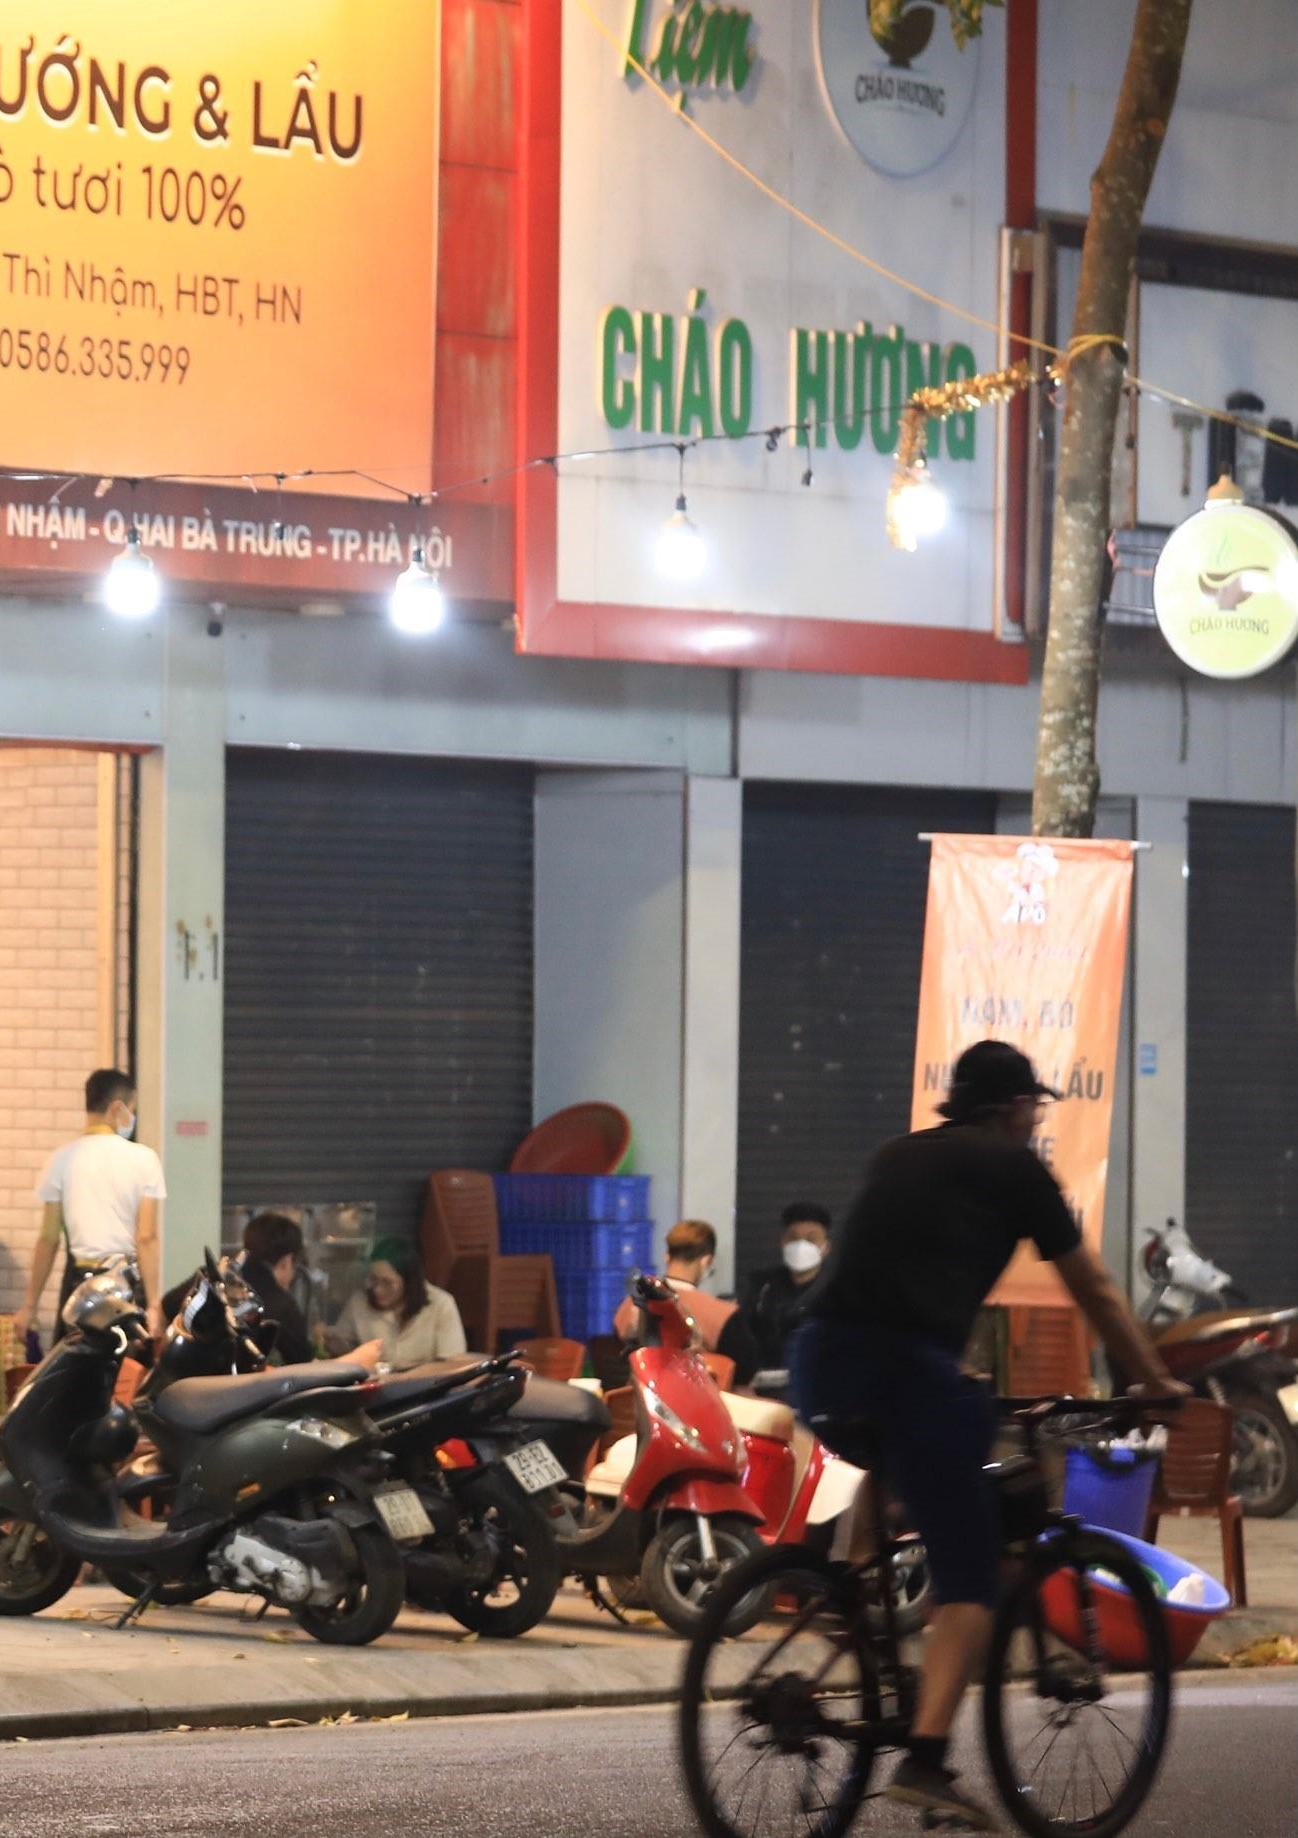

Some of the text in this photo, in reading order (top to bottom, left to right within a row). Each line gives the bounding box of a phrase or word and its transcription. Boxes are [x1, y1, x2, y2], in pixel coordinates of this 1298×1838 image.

[193, 74, 229, 141] &
[32, 155, 122, 217] tươi
[141, 164, 246, 231] 100%
[2, 252, 51, 298] Thì
[64, 260, 164, 319] Nhậm,
[175, 271, 245, 327] HBT,
[256, 281, 302, 325] HN
[596, 287, 978, 462] CHÁO HƯƠNG
[181, 507, 218, 552] BÀ
